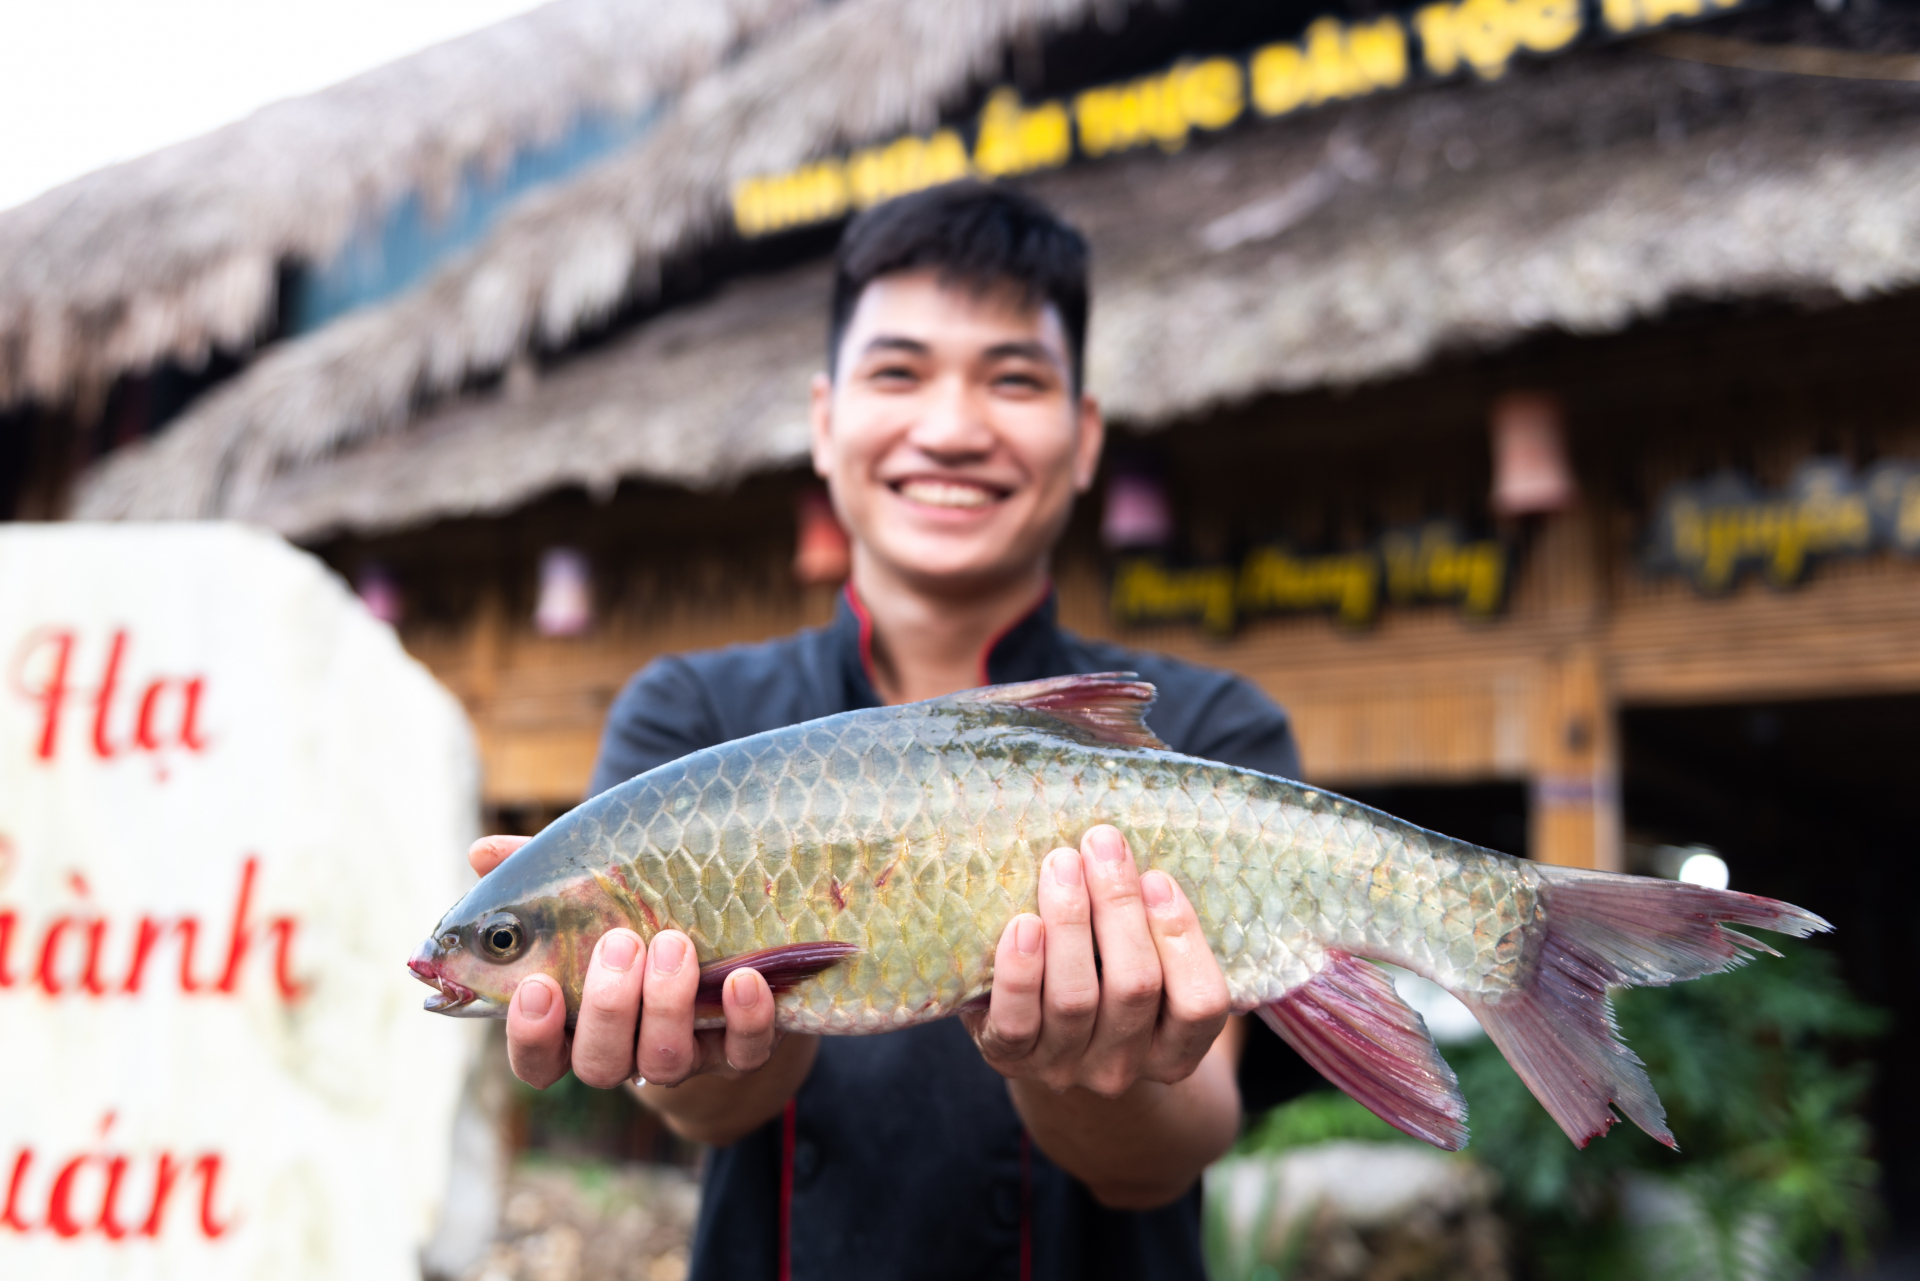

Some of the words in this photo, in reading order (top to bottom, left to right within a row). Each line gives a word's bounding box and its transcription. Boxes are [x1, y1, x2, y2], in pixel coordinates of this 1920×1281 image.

[8, 626, 214, 783] Hạ
[0, 830, 313, 1004] ành
[0, 1108, 240, 1241] án
